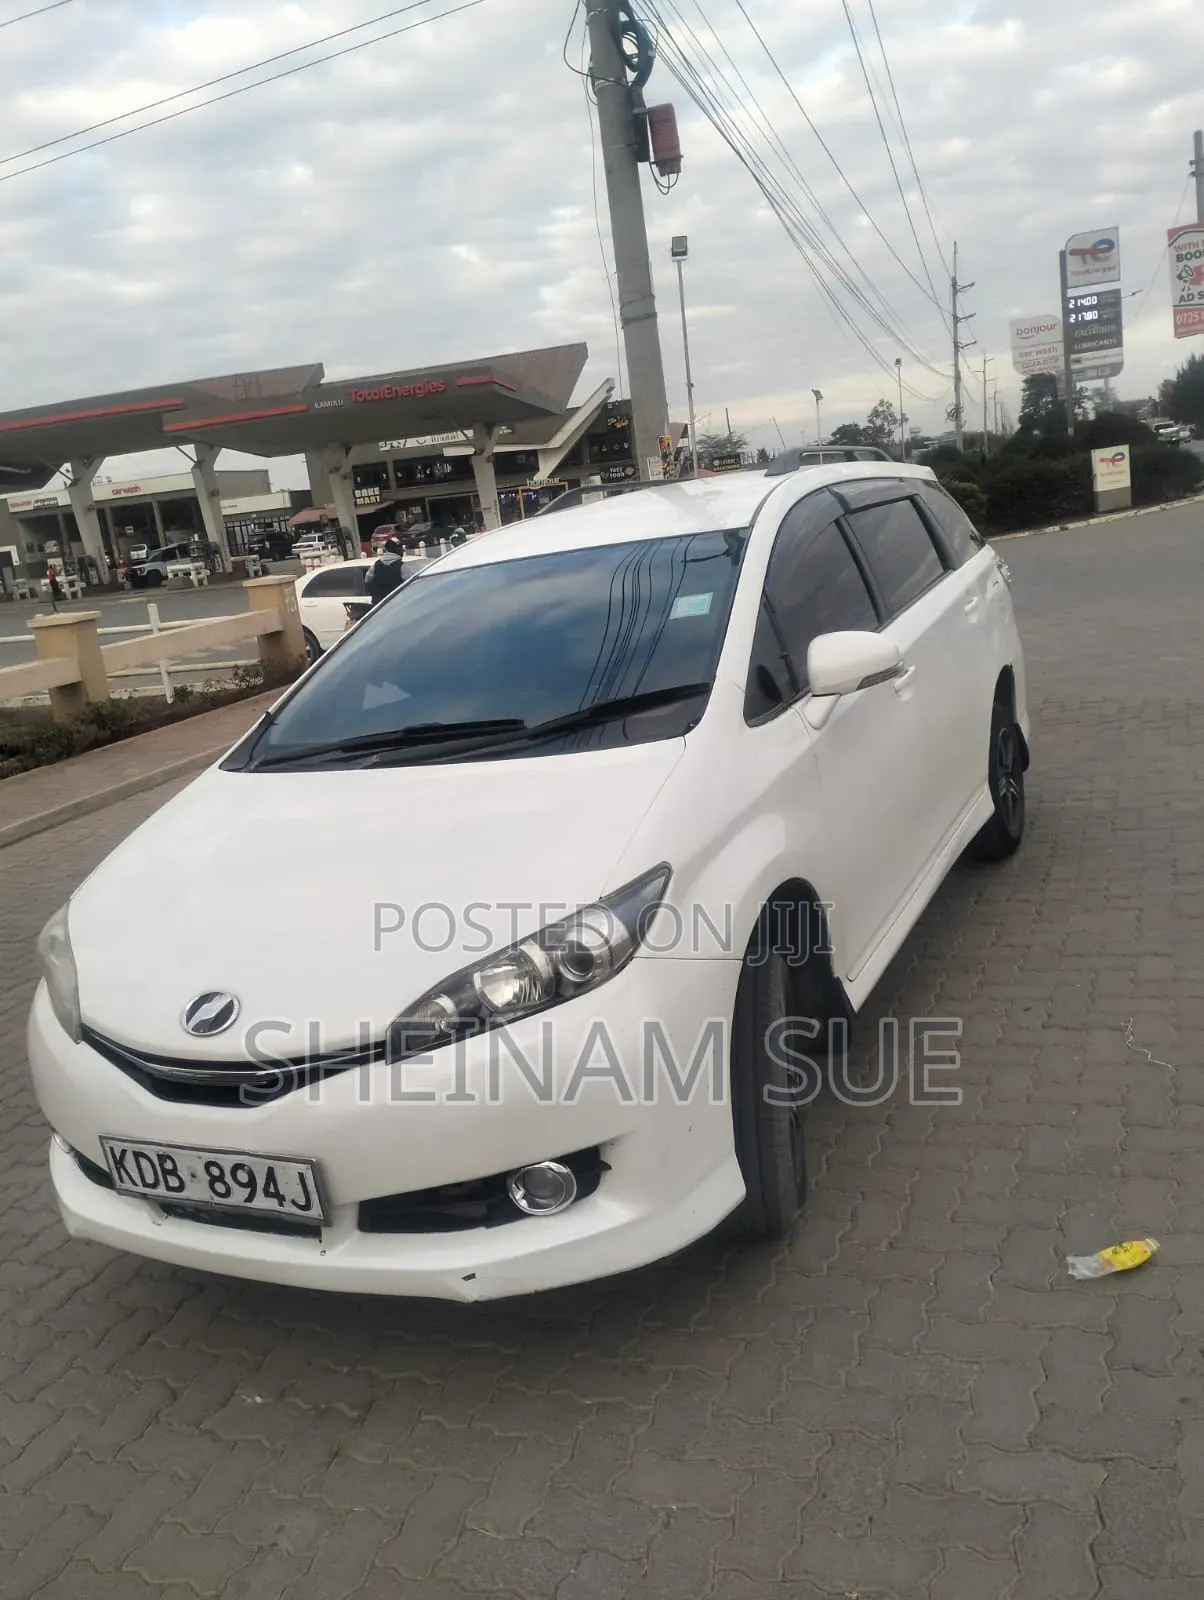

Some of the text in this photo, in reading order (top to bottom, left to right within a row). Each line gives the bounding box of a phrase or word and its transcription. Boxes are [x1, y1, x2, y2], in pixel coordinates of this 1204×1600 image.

[1179, 292, 1195, 304] AD
[1176, 311, 1199, 325] 0725
[1016, 323, 1056, 336] bonjour
[349, 379, 446, 402] TotalEnergies
[356, 495, 381, 505] MART
[108, 1145, 313, 1212] KDB 894J
